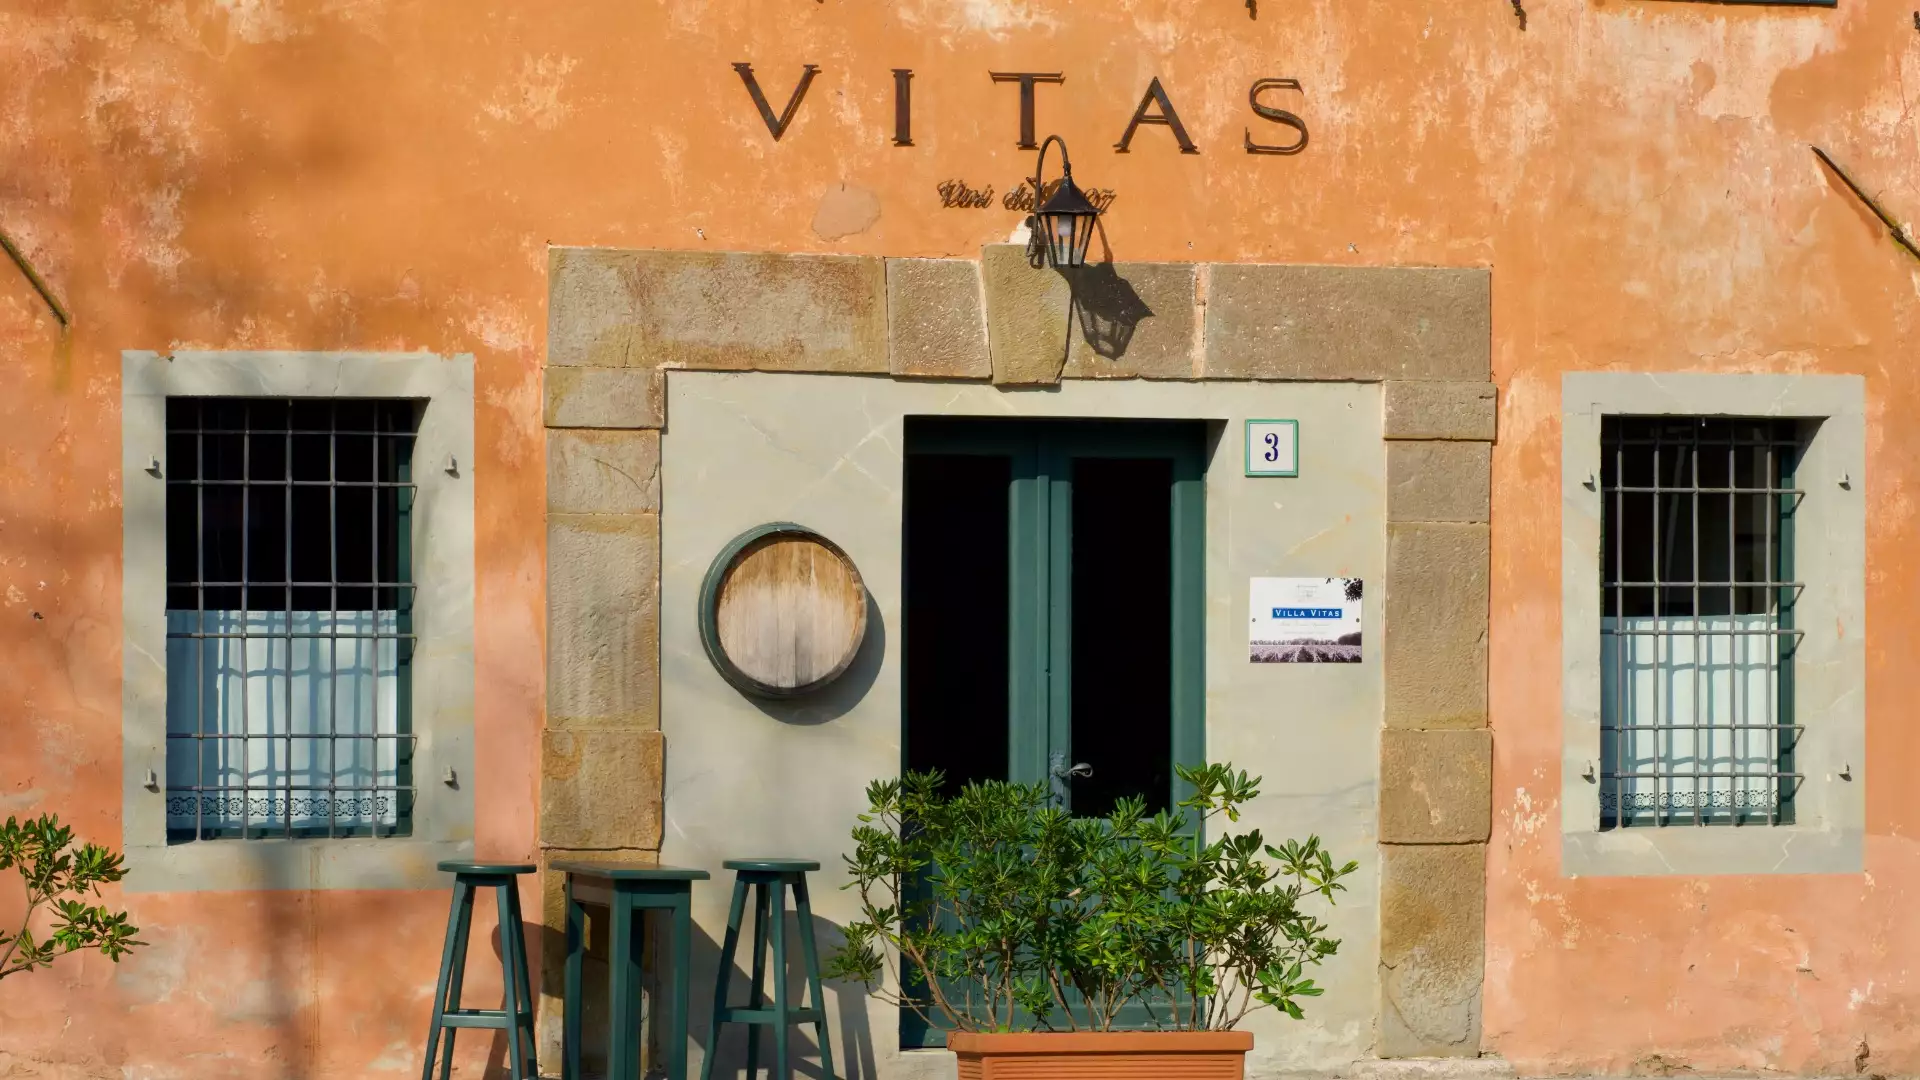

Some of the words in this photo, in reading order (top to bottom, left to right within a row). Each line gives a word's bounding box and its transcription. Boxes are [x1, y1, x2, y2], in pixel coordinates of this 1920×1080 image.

[731, 62, 1309, 155] VITAS
[936, 179, 994, 209] Vini
[1264, 432, 1279, 462] 3
